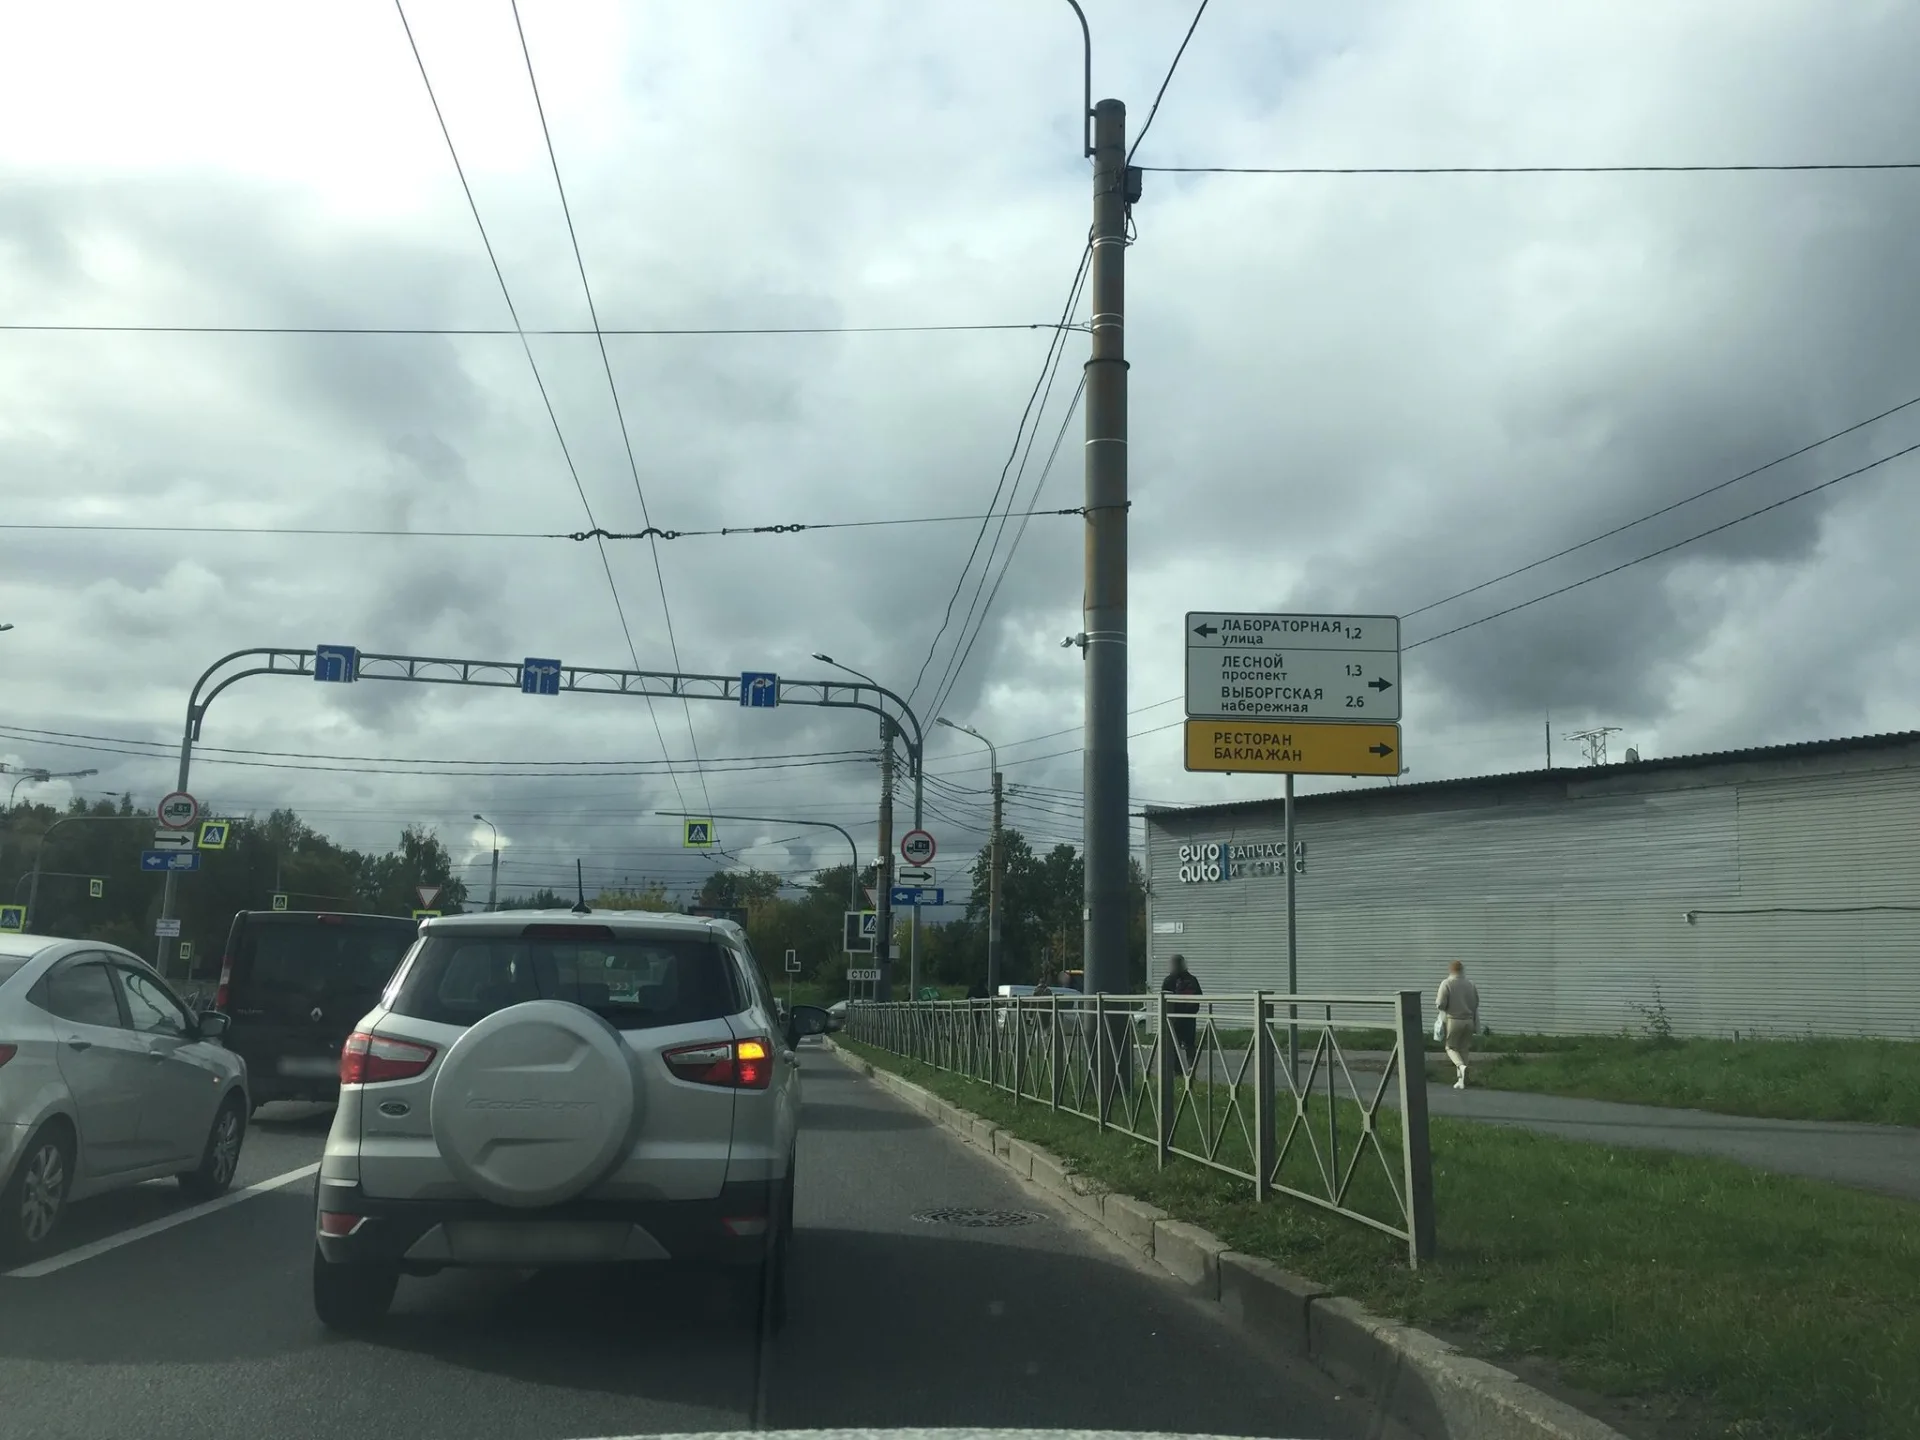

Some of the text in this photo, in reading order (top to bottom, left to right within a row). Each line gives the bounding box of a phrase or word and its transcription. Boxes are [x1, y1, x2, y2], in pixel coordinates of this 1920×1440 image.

[1221, 619, 1342, 633] ЛАБОРАТОРНАЯ
[1221, 634, 1264, 645] улица
[1221, 654, 1284, 668] ЛЕСНОЙ
[1221, 670, 1288, 682] проспект
[1221, 686, 1323, 700] ВЫБОРГСКАЯ
[1221, 700, 1309, 714] набережная
[1214, 732, 1292, 746] РЕСТОРАН
[1214, 748, 1302, 762] БАКЛАЖАН
[1179, 843, 1220, 862] euro
[1229, 842, 1303, 859] ЗАПЧАСИ
[1179, 861, 1221, 882] auto
[1229, 864, 1239, 876] И
[851, 970, 876, 979] СТОП
